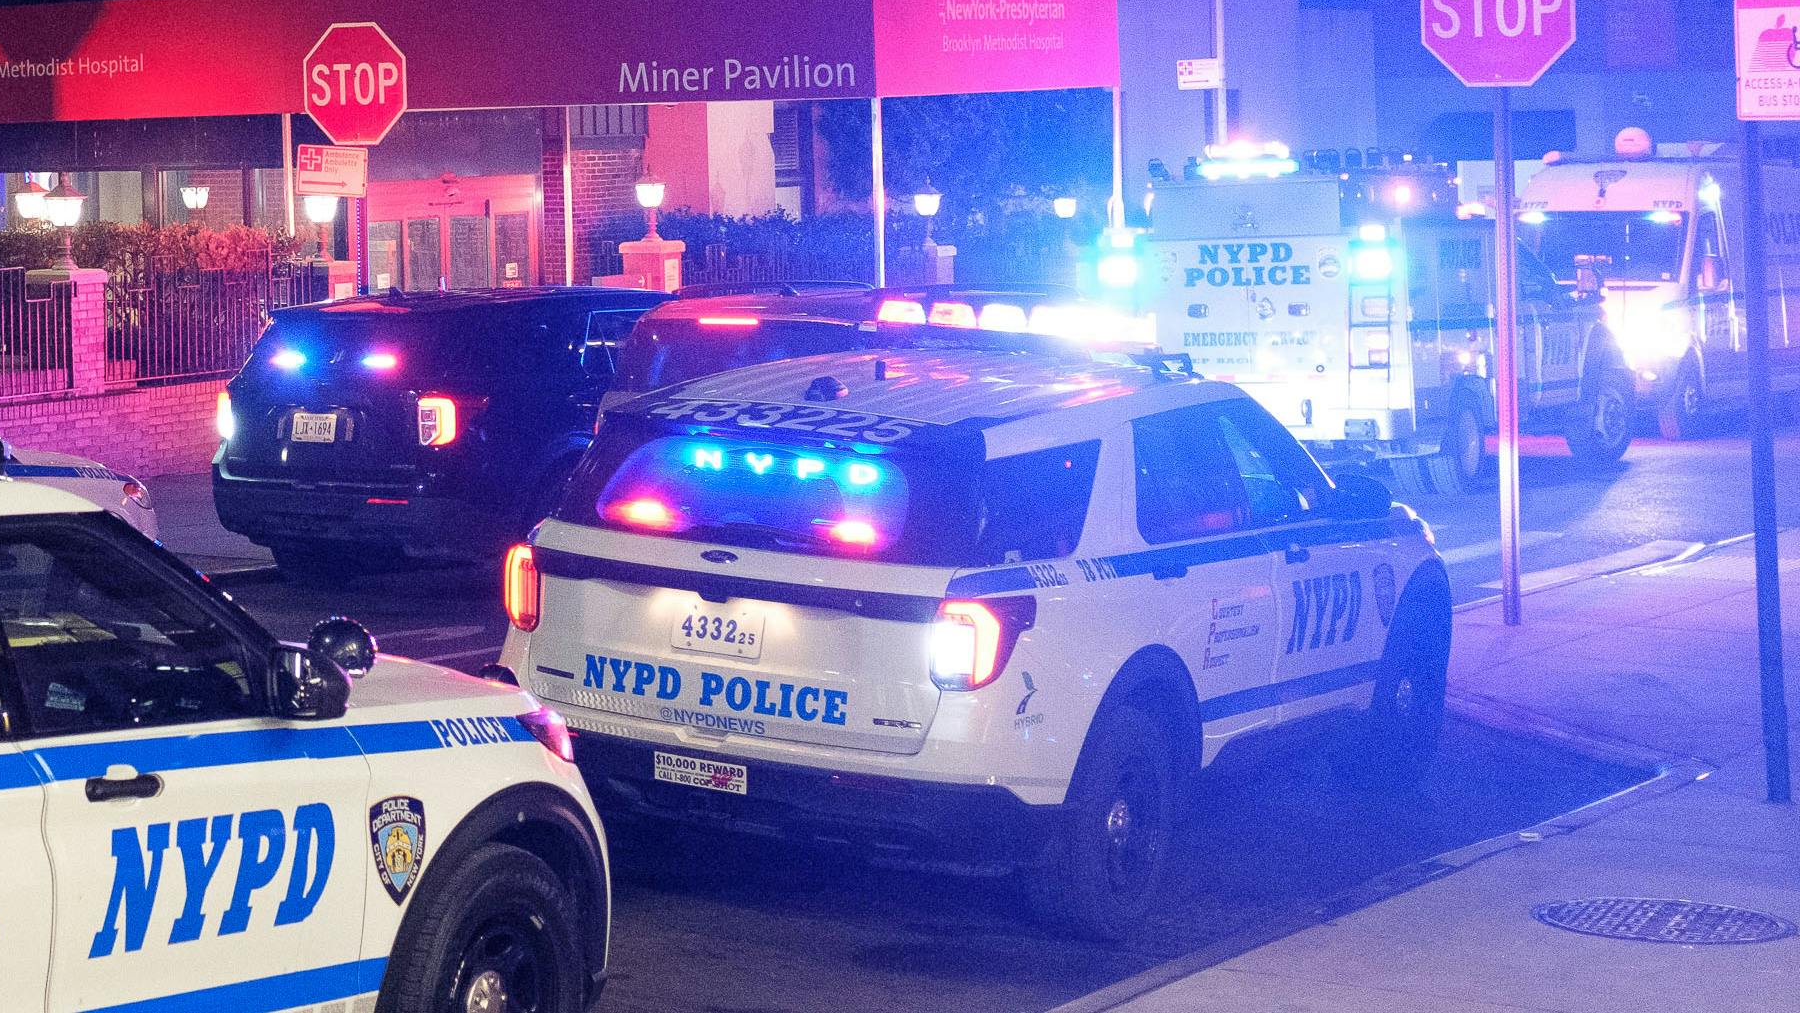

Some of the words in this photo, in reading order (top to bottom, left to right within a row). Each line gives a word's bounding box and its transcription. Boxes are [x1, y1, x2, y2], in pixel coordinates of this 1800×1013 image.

[942, 34, 982, 56] Brooklyn
[983, 33, 1028, 52] Methodist
[1029, 31, 1064, 54] Hospital
[78, 52, 144, 79] Hospital
[618, 60, 714, 93] Miner
[724, 54, 856, 90] Pavilion
[311, 61, 399, 107] STOP
[1744, 78, 1800, 90] ACCESS-A-
[1758, 94, 1778, 107] BUS
[1197, 242, 1294, 265] NYPD
[1183, 265, 1312, 288] POLICE
[1183, 331, 1258, 347] EMERGENCY
[647, 399, 926, 443] 433225
[1286, 570, 1362, 655] NYPD
[583, 653, 682, 701] NYPD
[699, 671, 849, 726] POLICE
[431, 716, 511, 748] POLICE
[659, 706, 766, 736] @NYPDNEWS
[1014, 712, 1044, 730] HYBRID
[655, 754, 697, 770] $10,000
[699, 762, 744, 778] REWARD
[658, 770, 673, 781] CALL
[382, 799, 410, 813] POLICE
[372, 809, 422, 833] DEPARTMENT
[373, 843, 385, 869] CITY
[381, 871, 392, 886] OF
[407, 863, 419, 888] NEW
[415, 833, 424, 863] YORK
[88, 802, 336, 960] NYPD
